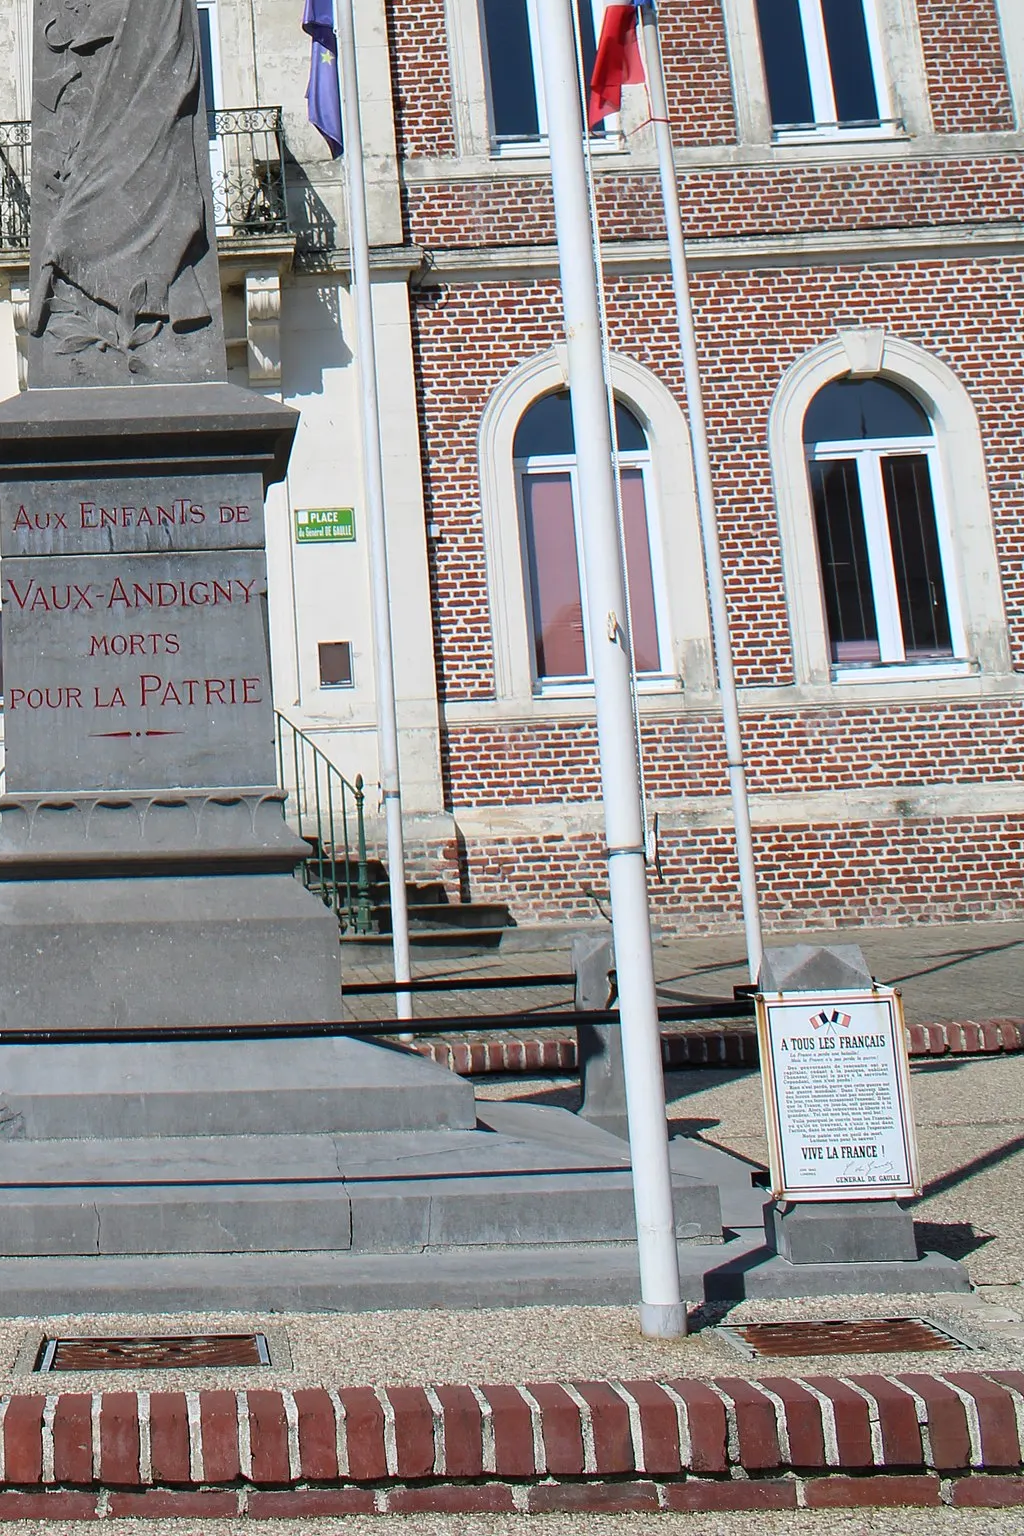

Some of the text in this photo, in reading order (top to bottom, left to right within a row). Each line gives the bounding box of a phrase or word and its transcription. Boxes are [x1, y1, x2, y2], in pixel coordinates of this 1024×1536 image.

[12, 504, 68, 531] AUX
[219, 505, 252, 524] DE
[310, 512, 338, 523] PLACE
[325, 525, 332, 536] DE
[7, 576, 257, 612] VAUX-ANDIGNY
[89, 633, 180, 657] MORTS
[9, 674, 263, 710] POUR LA PATRIE
[781, 1035, 885, 1051] A TOUS LES FRANÇAIS
[801, 1147, 824, 1160] VIVE
[826, 1146, 839, 1159] LA
[841, 1145, 877, 1159] FRANCE
